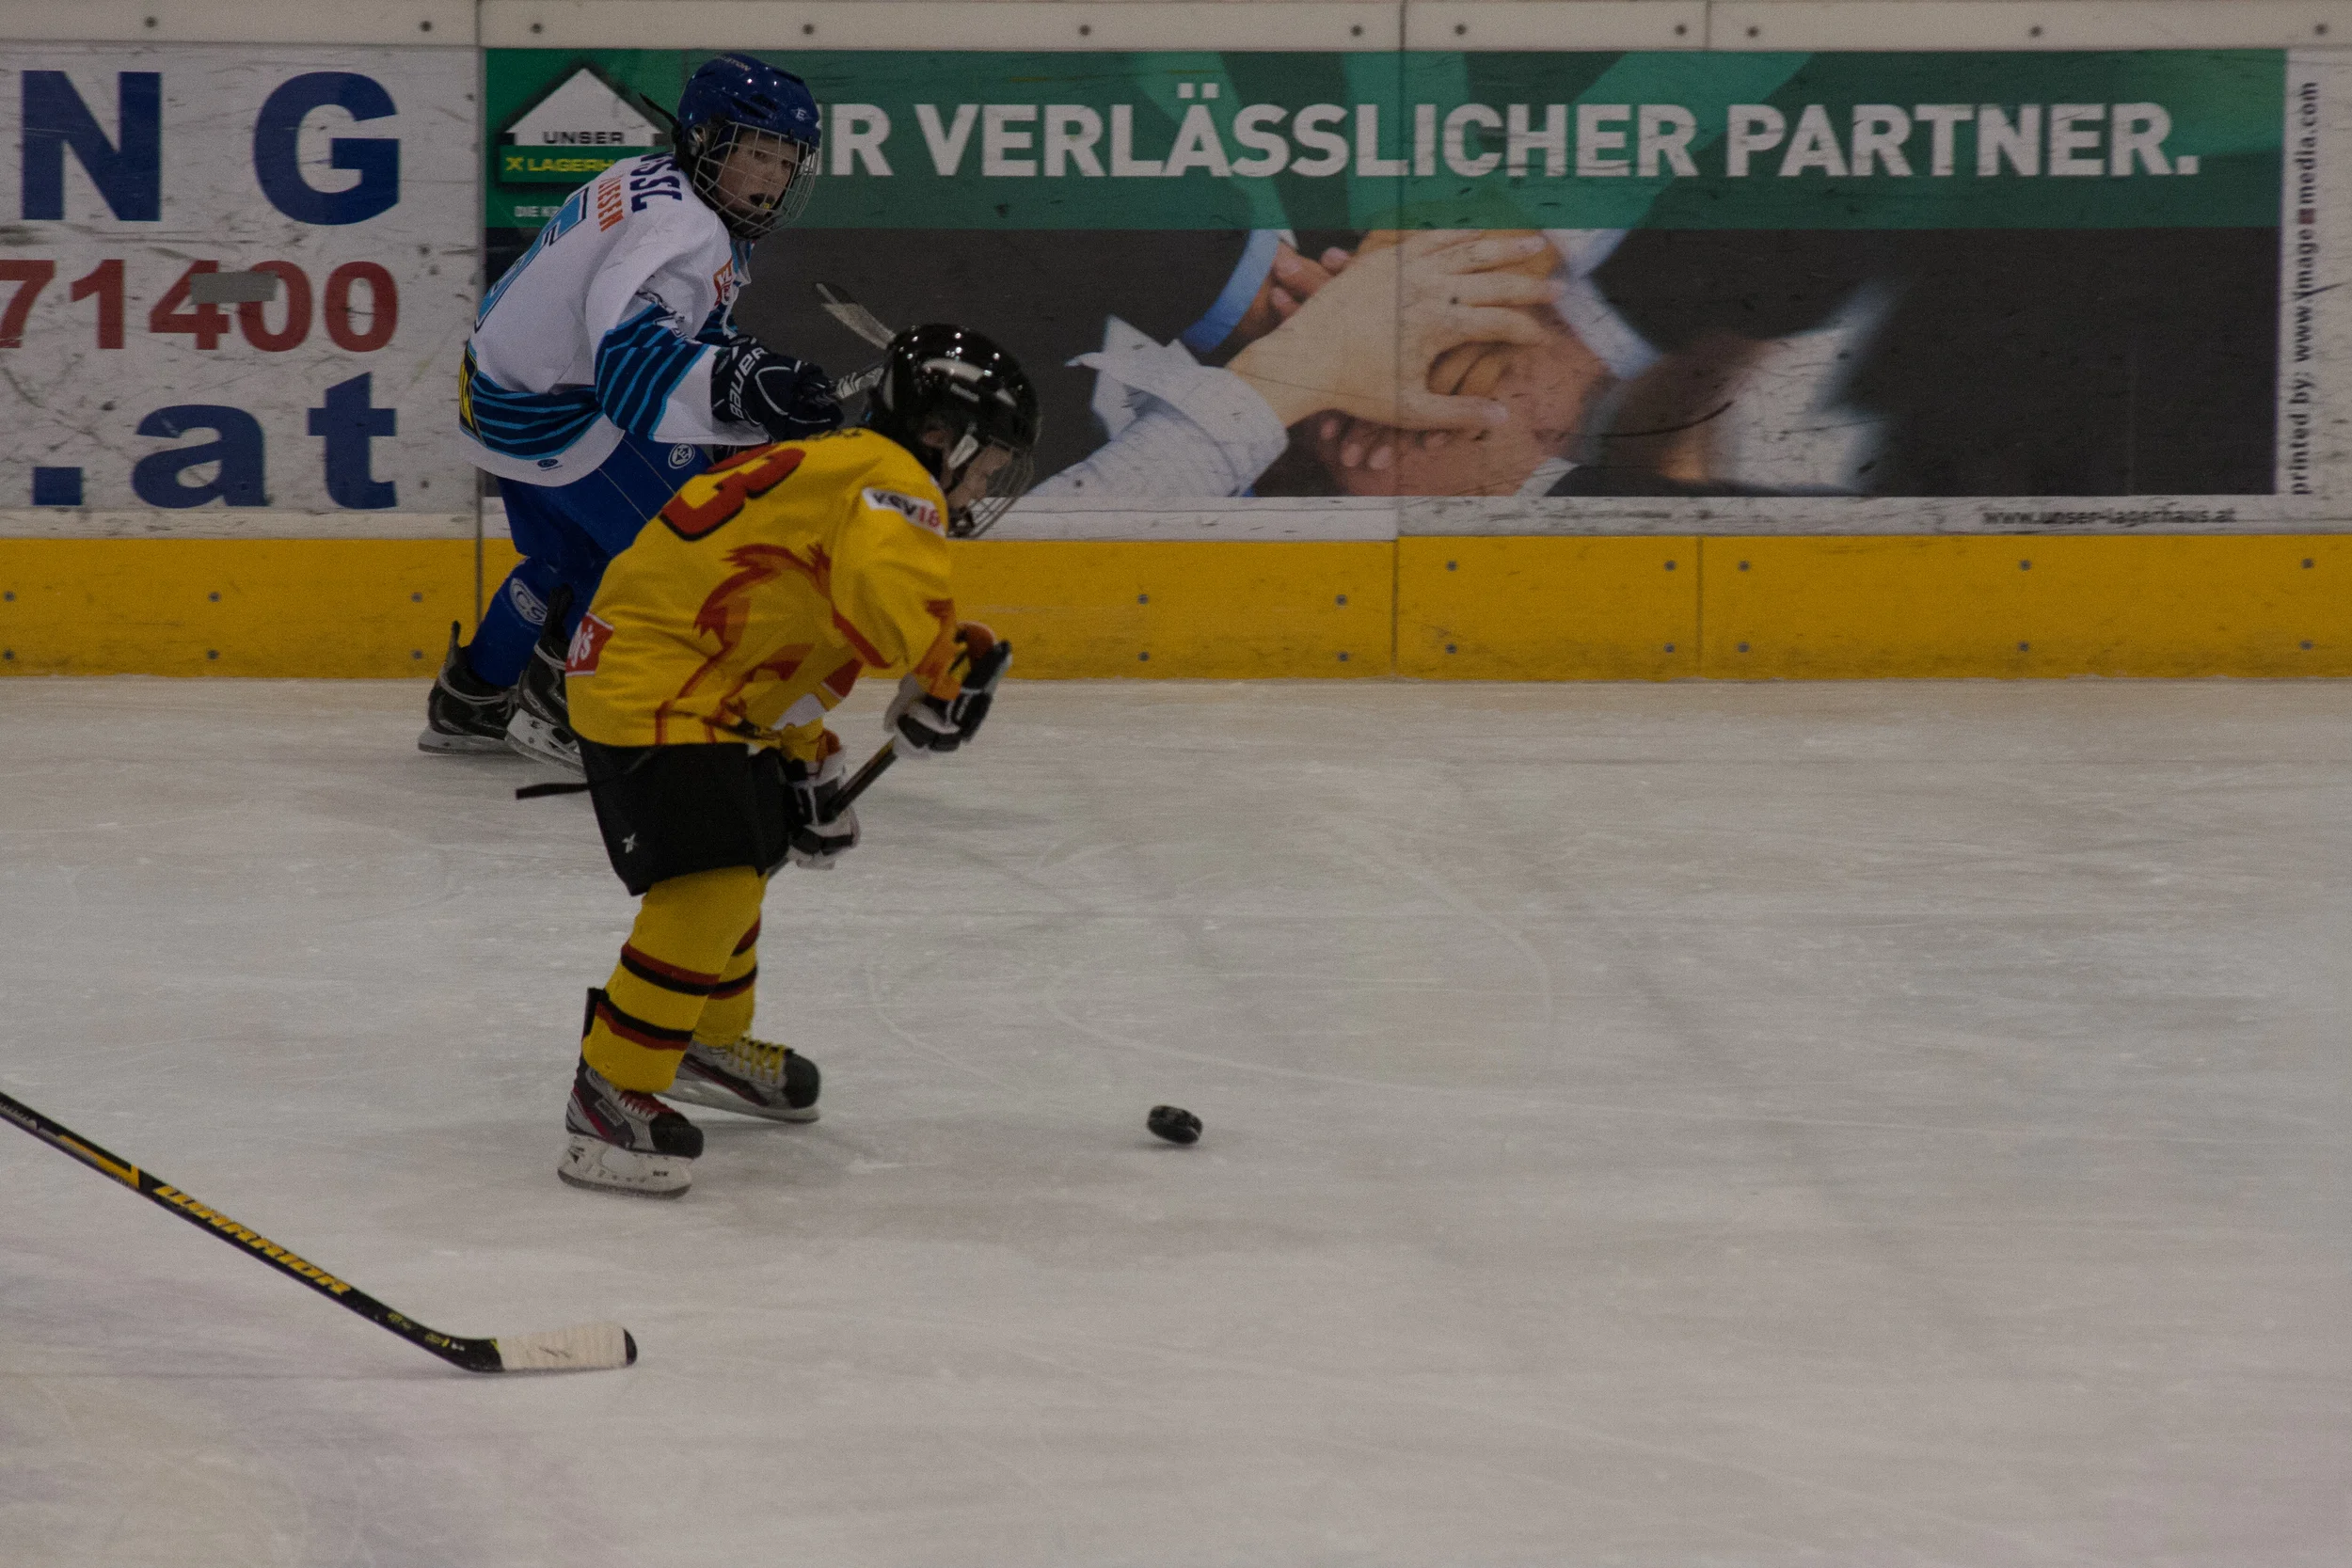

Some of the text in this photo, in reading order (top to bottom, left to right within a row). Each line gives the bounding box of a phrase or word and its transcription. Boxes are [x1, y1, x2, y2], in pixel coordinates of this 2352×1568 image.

[543, 131, 623, 145] UNSER
[914, 82, 1699, 178] VERLÄSSLICHER
[1725, 102, 2200, 177] PARTNER.
[0, 259, 399, 353] 71400
[729, 345, 770, 420] BAUER
[33, 371, 398, 509] .at
[2288, 414, 2313, 496] printed
[152, 1184, 352, 1296] WARRIOR
